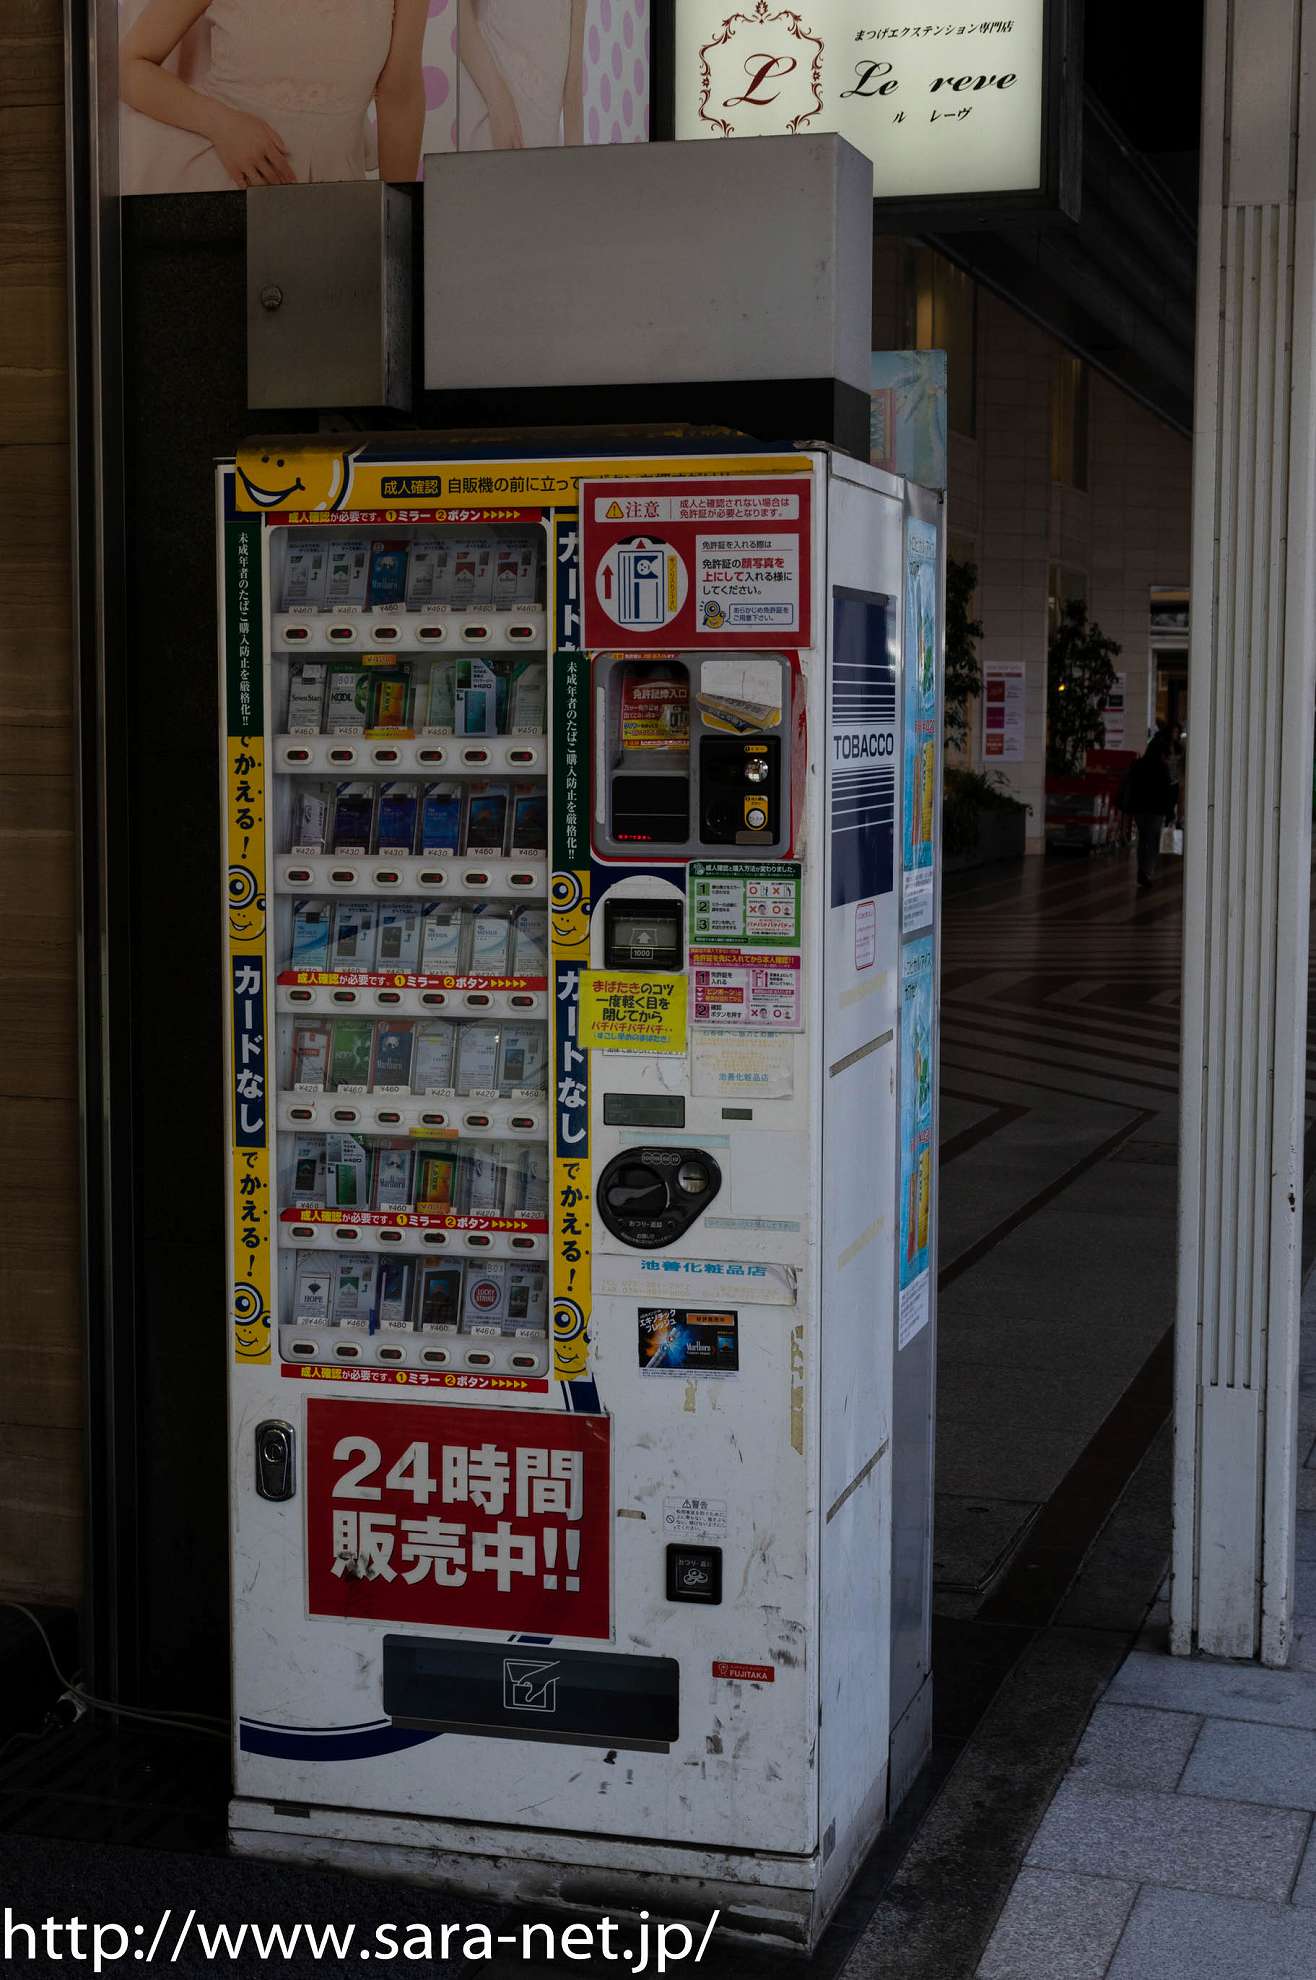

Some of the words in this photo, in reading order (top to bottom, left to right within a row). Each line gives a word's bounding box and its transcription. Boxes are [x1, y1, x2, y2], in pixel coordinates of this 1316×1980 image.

[854, 20, 1015, 42] まつげエクステンション専門店
[722, 53, 797, 108] L
[840, 60, 899, 99] Le
[929, 72, 1018, 93] reve
[893, 111, 906, 123] ル
[930, 107, 973, 122] レーヴ
[383, 479, 439, 497] 成人確認
[626, 501, 660, 519] 注意
[679, 498, 790, 510] 成人と確認されない場合は
[679, 508, 783, 519] 免許証が必要となります。
[702, 540, 772, 549] 免許証を入れる際は
[702, 557, 785, 570] 免許証の顔写真を
[702, 571, 793, 583] 上にして入れる様に
[702, 585, 762, 595] してください。
[833, 733, 894, 760] TOBACCO
[592, 980, 674, 996] まばたきのコツ
[596, 994, 670, 1010] 一度軽く目を
[602, 1007, 663, 1023] 閉じてから
[234, 964, 265, 1138] カードなし
[331, 1436, 584, 1521] 24時間
[330, 1509, 581, 1592] 販売中!!
[729, 1669, 768, 1680] FUJITAKA
